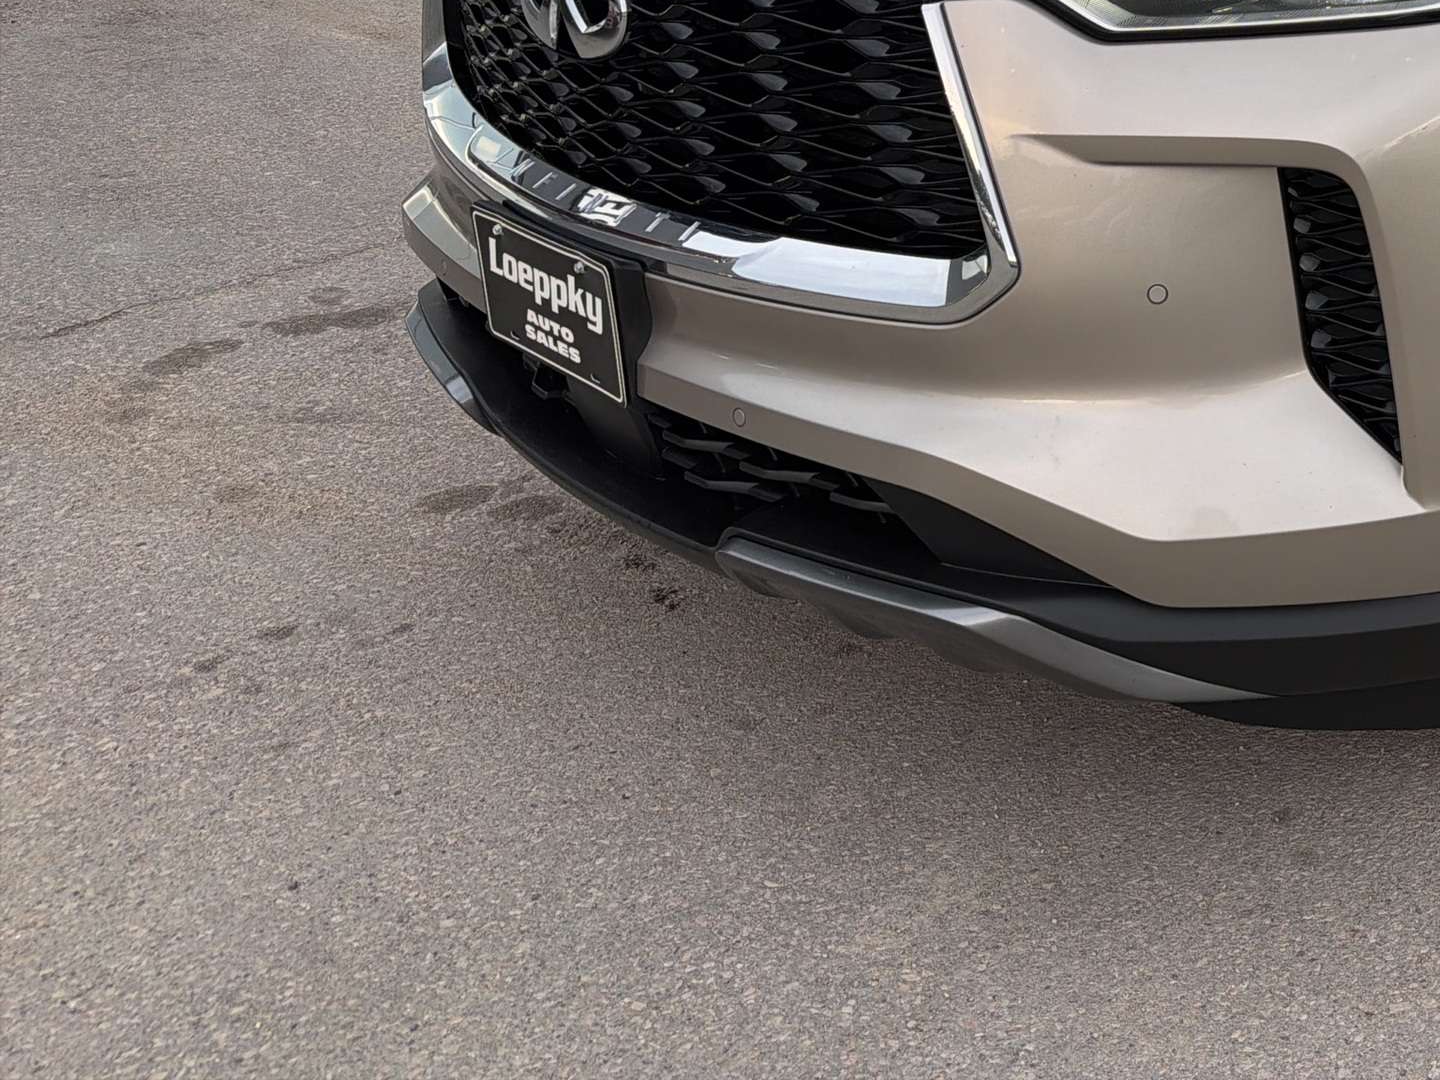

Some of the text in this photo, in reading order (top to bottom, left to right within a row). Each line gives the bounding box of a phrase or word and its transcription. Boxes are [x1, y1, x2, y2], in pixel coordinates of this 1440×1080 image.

[488, 236, 604, 335] Loeppky
[524, 323, 582, 364] SALES
[526, 308, 575, 344] AUTO
